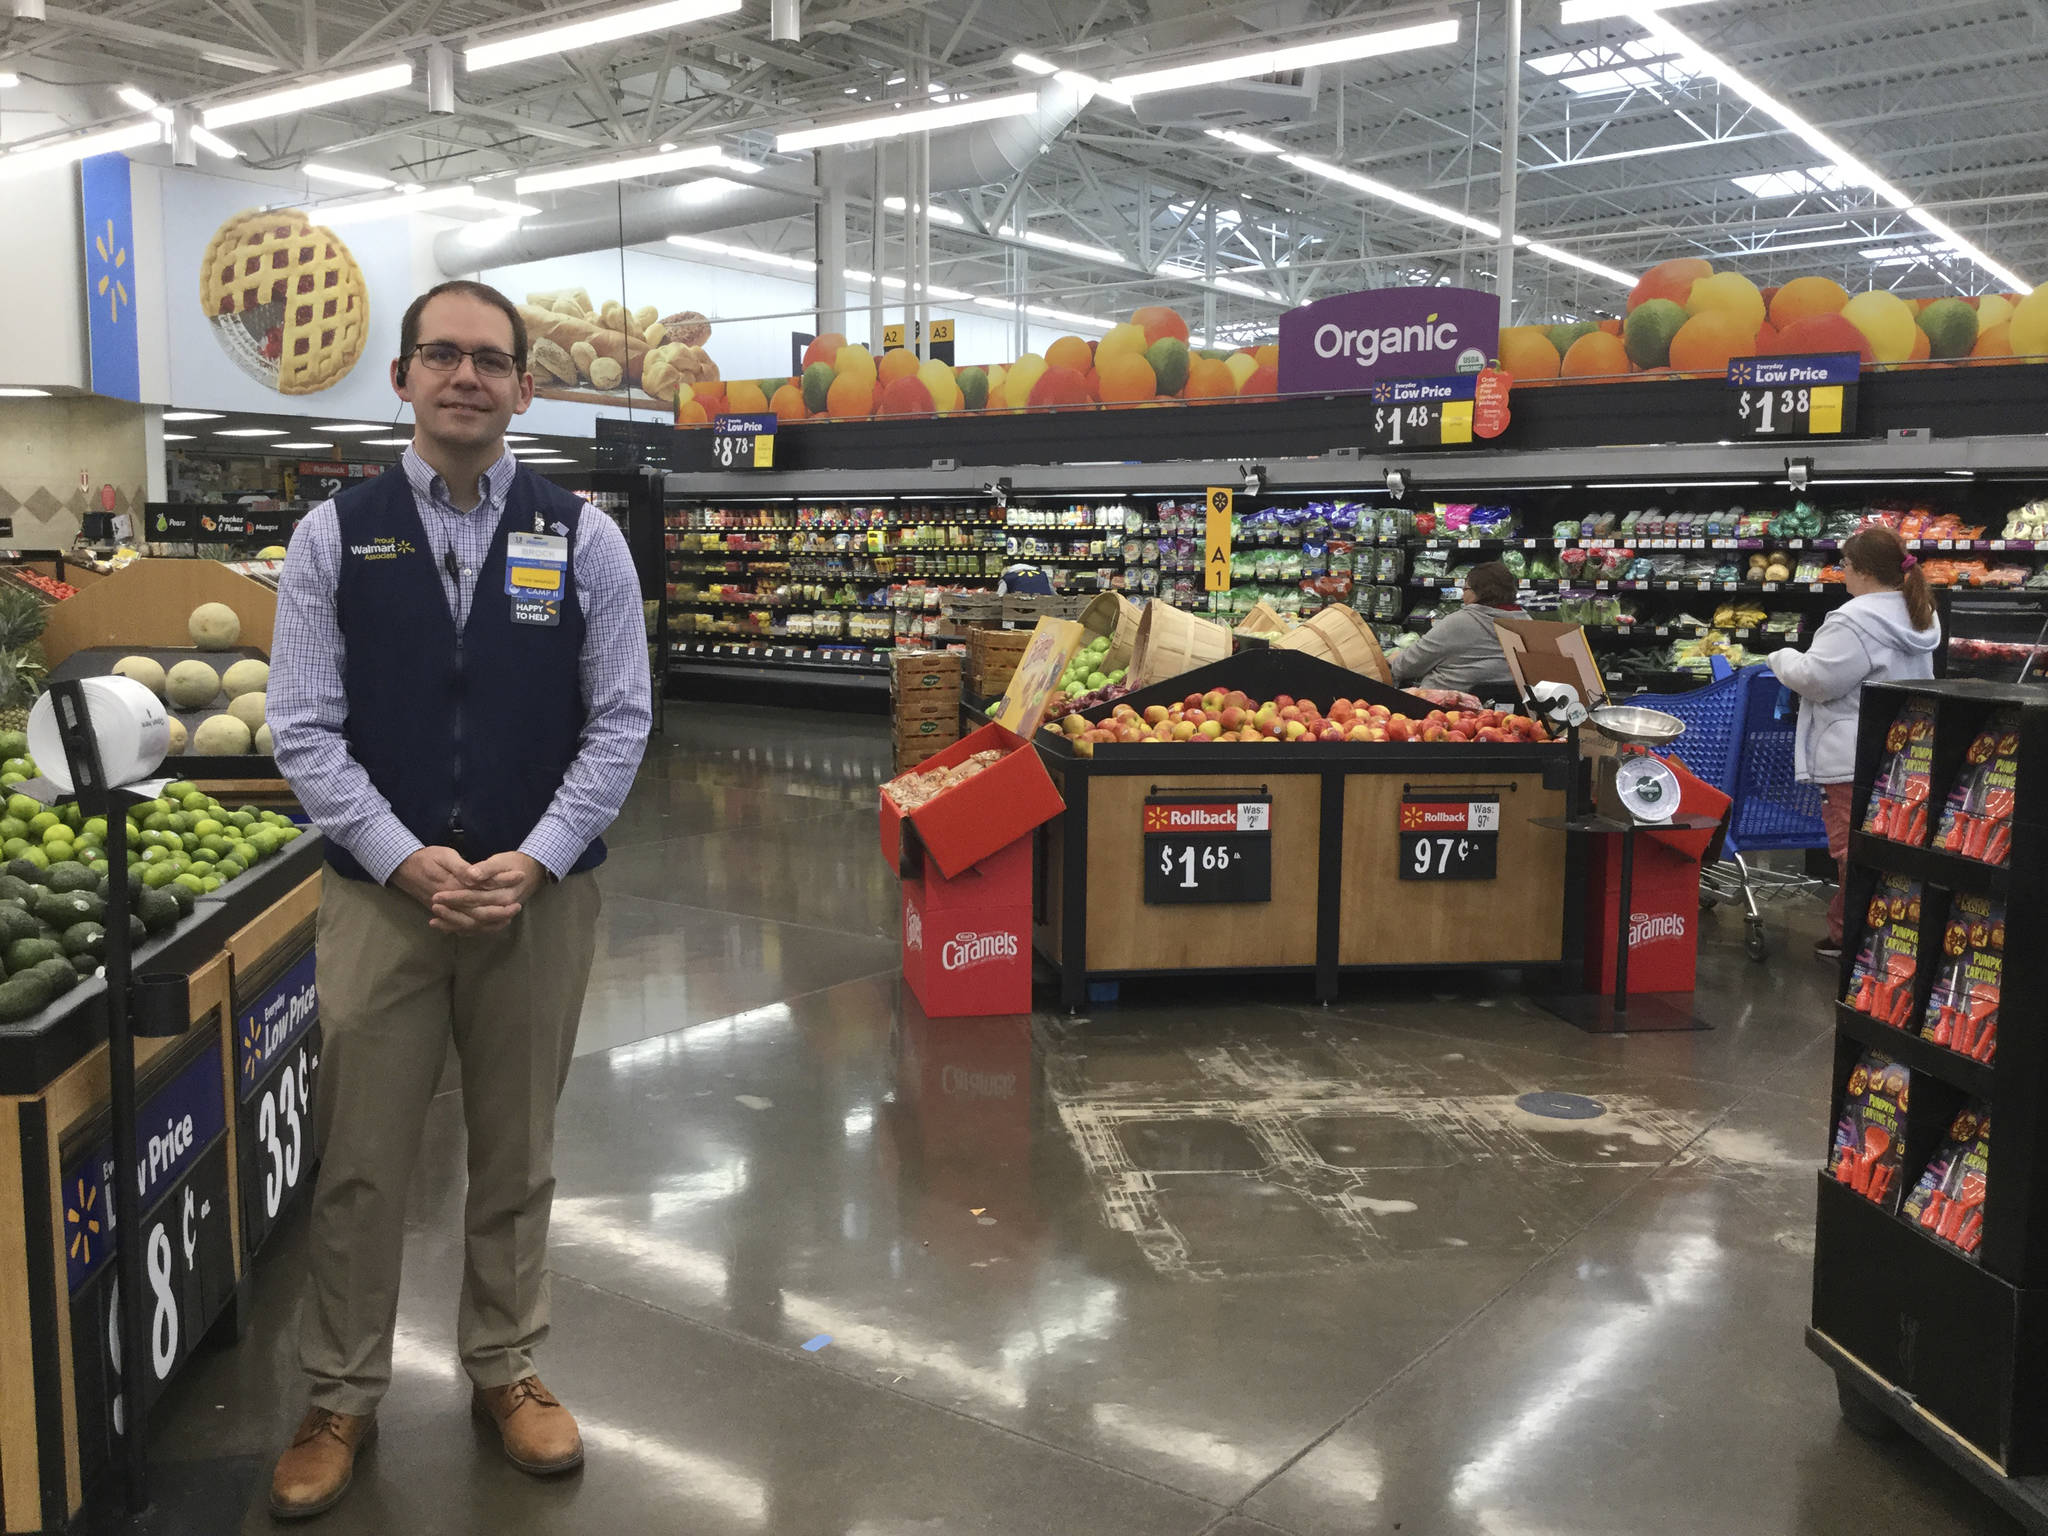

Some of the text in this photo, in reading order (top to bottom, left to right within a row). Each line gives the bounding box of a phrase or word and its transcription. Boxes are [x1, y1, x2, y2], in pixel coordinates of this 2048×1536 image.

[884, 332, 897, 343] A2
[933, 327, 948, 339] A3
[1314, 314, 1458, 367] Organic
[1755, 366, 1828, 382] Low Price
[1394, 385, 1452, 400] Low Price
[727, 422, 763, 432] Low Price
[169, 518, 187, 527] Pears
[218, 514, 244, 523] Peaches
[224, 524, 244, 532] Plums
[351, 543, 396, 555] Walmart
[1211, 546, 1226, 564] A
[1215, 570, 1221, 587] 1
[526, 587, 551, 597] CAMP
[516, 603, 544, 612] HAPPY
[516, 612, 550, 621] TO HELP
[1243, 805, 1264, 814] Was:
[1474, 804, 1495, 814] Was:
[1170, 809, 1237, 826] Rollback
[1424, 812, 1466, 822] Rollback
[1628, 913, 1685, 946] aramels
[942, 931, 1018, 971] Caramels
[264, 992, 285, 1021] Everyday
[264, 984, 316, 1060] Low Price
[1868, 1093, 1897, 1115] PUMPKIN
[1863, 1105, 1899, 1132] CARVING KIT
[148, 1114, 193, 1185] Price
